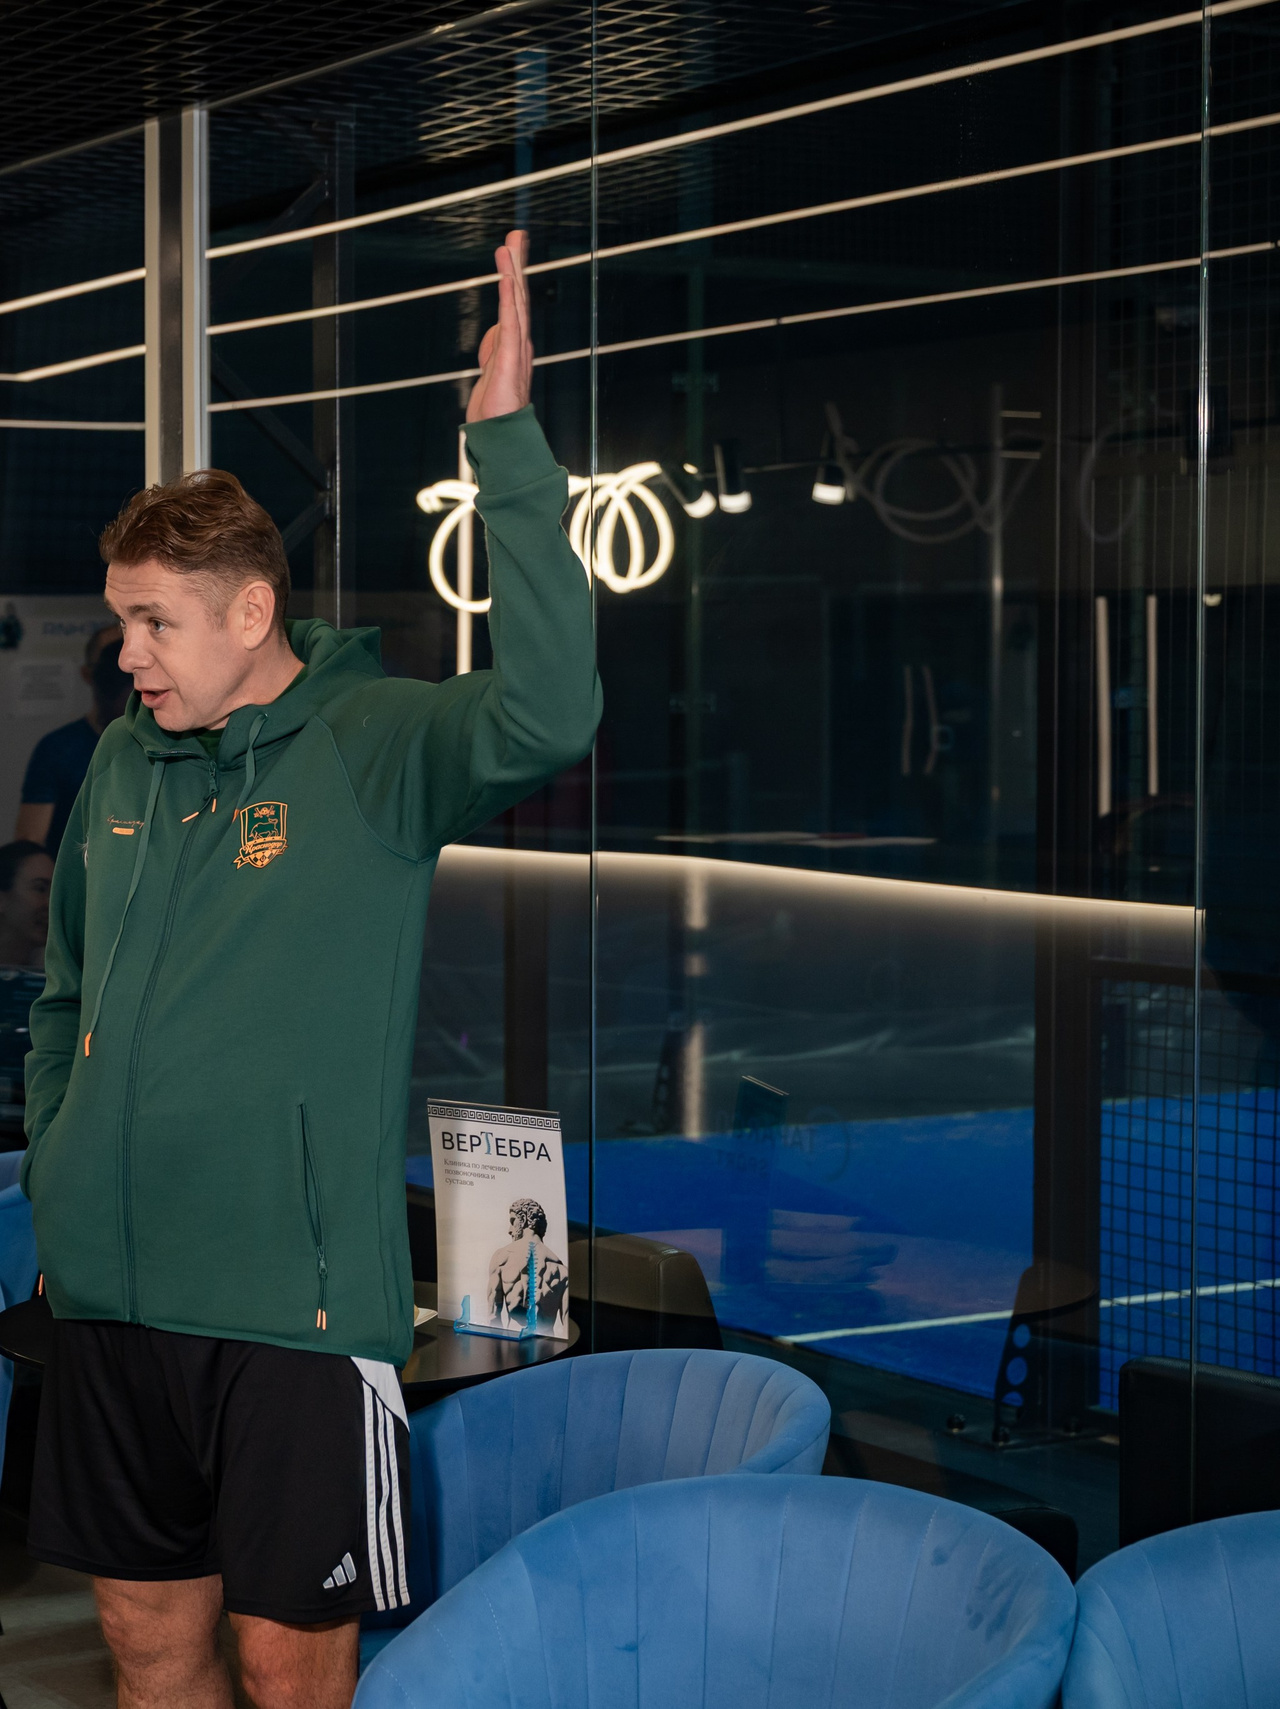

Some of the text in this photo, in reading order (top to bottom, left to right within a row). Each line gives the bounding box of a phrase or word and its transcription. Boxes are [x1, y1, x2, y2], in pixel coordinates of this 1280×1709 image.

[441, 1131, 552, 1163] ВЕРТЕБРА
[443, 1158, 471, 1169] Клиника
[480, 1164, 510, 1173] лечению
[444, 1168, 490, 1180] позвоночника
[444, 1177, 475, 1187] суставов
